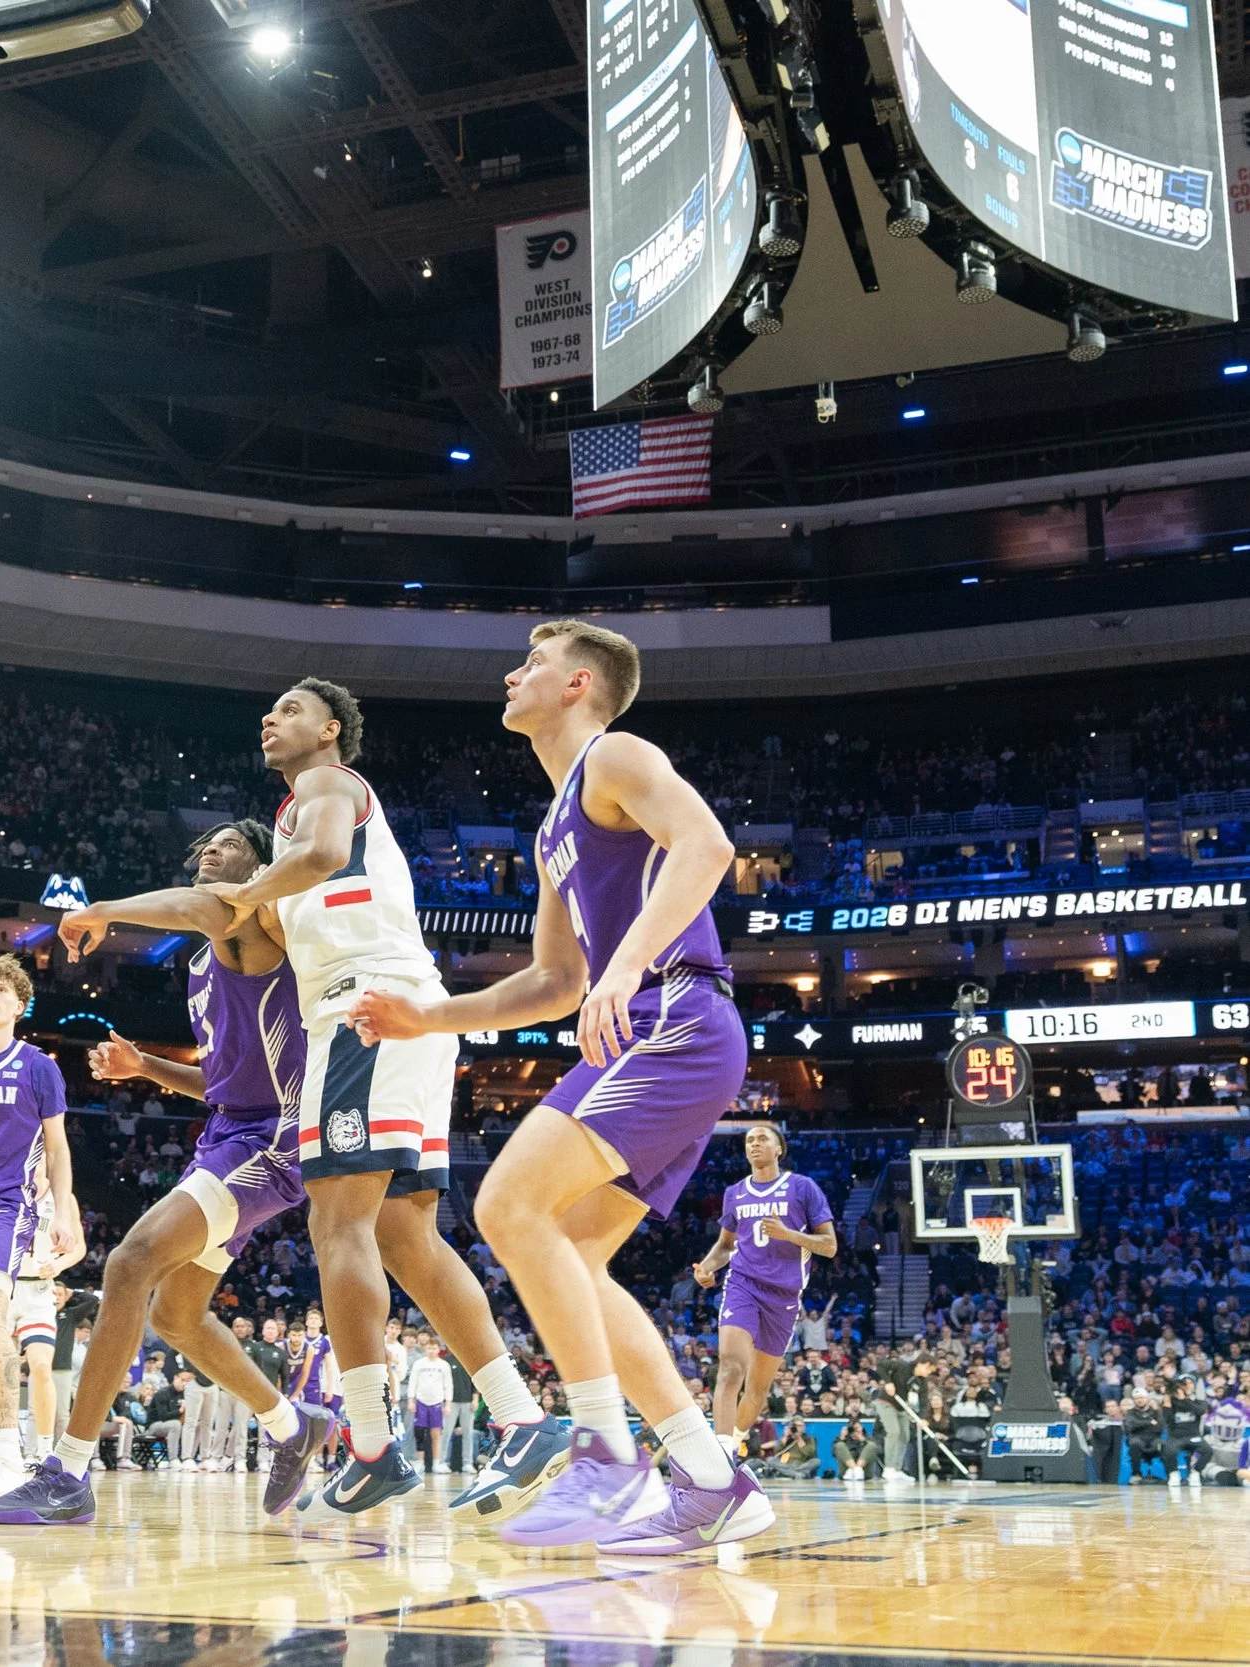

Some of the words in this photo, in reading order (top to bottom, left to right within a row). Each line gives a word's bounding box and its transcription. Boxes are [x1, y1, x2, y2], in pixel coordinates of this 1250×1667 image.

[1094, 8, 1149, 40] TURNOVERS
[1159, 30, 1174, 47] 12
[1077, 24, 1114, 50] CHANCE
[1114, 39, 1151, 63] POINTS
[1064, 41, 1083, 60] PTS
[1083, 50, 1101, 67] OFF
[1101, 56, 1120, 75] THE
[1119, 64, 1153, 86] BENCH
[645, 79, 678, 121] TURNOVERS
[950, 101, 989, 149] TIMEOUTS
[632, 124, 657, 155] CHANCE
[648, 143, 660, 162] THE
[998, 145, 1025, 175] FOULS
[1081, 143, 1163, 198] MARCH
[985, 193, 1018, 229] BONUS
[1092, 177, 1207, 238] MADNESS
[630, 212, 684, 286] MARCH
[638, 219, 705, 308] MADNESS
[534, 278, 571, 296] WEST
[525, 291, 581, 313] DIVISION
[515, 303, 592, 328] CHAMPIONS
[530, 333, 581, 353] 1967-68
[532, 350, 580, 369] 1973-74
[832, 904, 908, 930] 2026
[914, 901, 951, 925] DI
[957, 895, 1047, 921] MEN'S
[1055, 883, 1247, 916] BASKETBALL
[1027, 1012, 1098, 1037] 10:16
[1132, 1014, 1163, 1028] 2ND
[1212, 1004, 1250, 1030] 63
[517, 1031, 549, 1044] 3PT%
[753, 1035, 765, 1049] 2
[852, 1023, 922, 1043] FURMAN
[968, 1047, 1014, 1067] 10:16
[966, 1067, 1013, 1099] 24
[736, 1202, 788, 1220] FURMAN
[1006, 1426, 1048, 1438] MARCH
[1011, 1438, 1068, 1450] MADNESS
